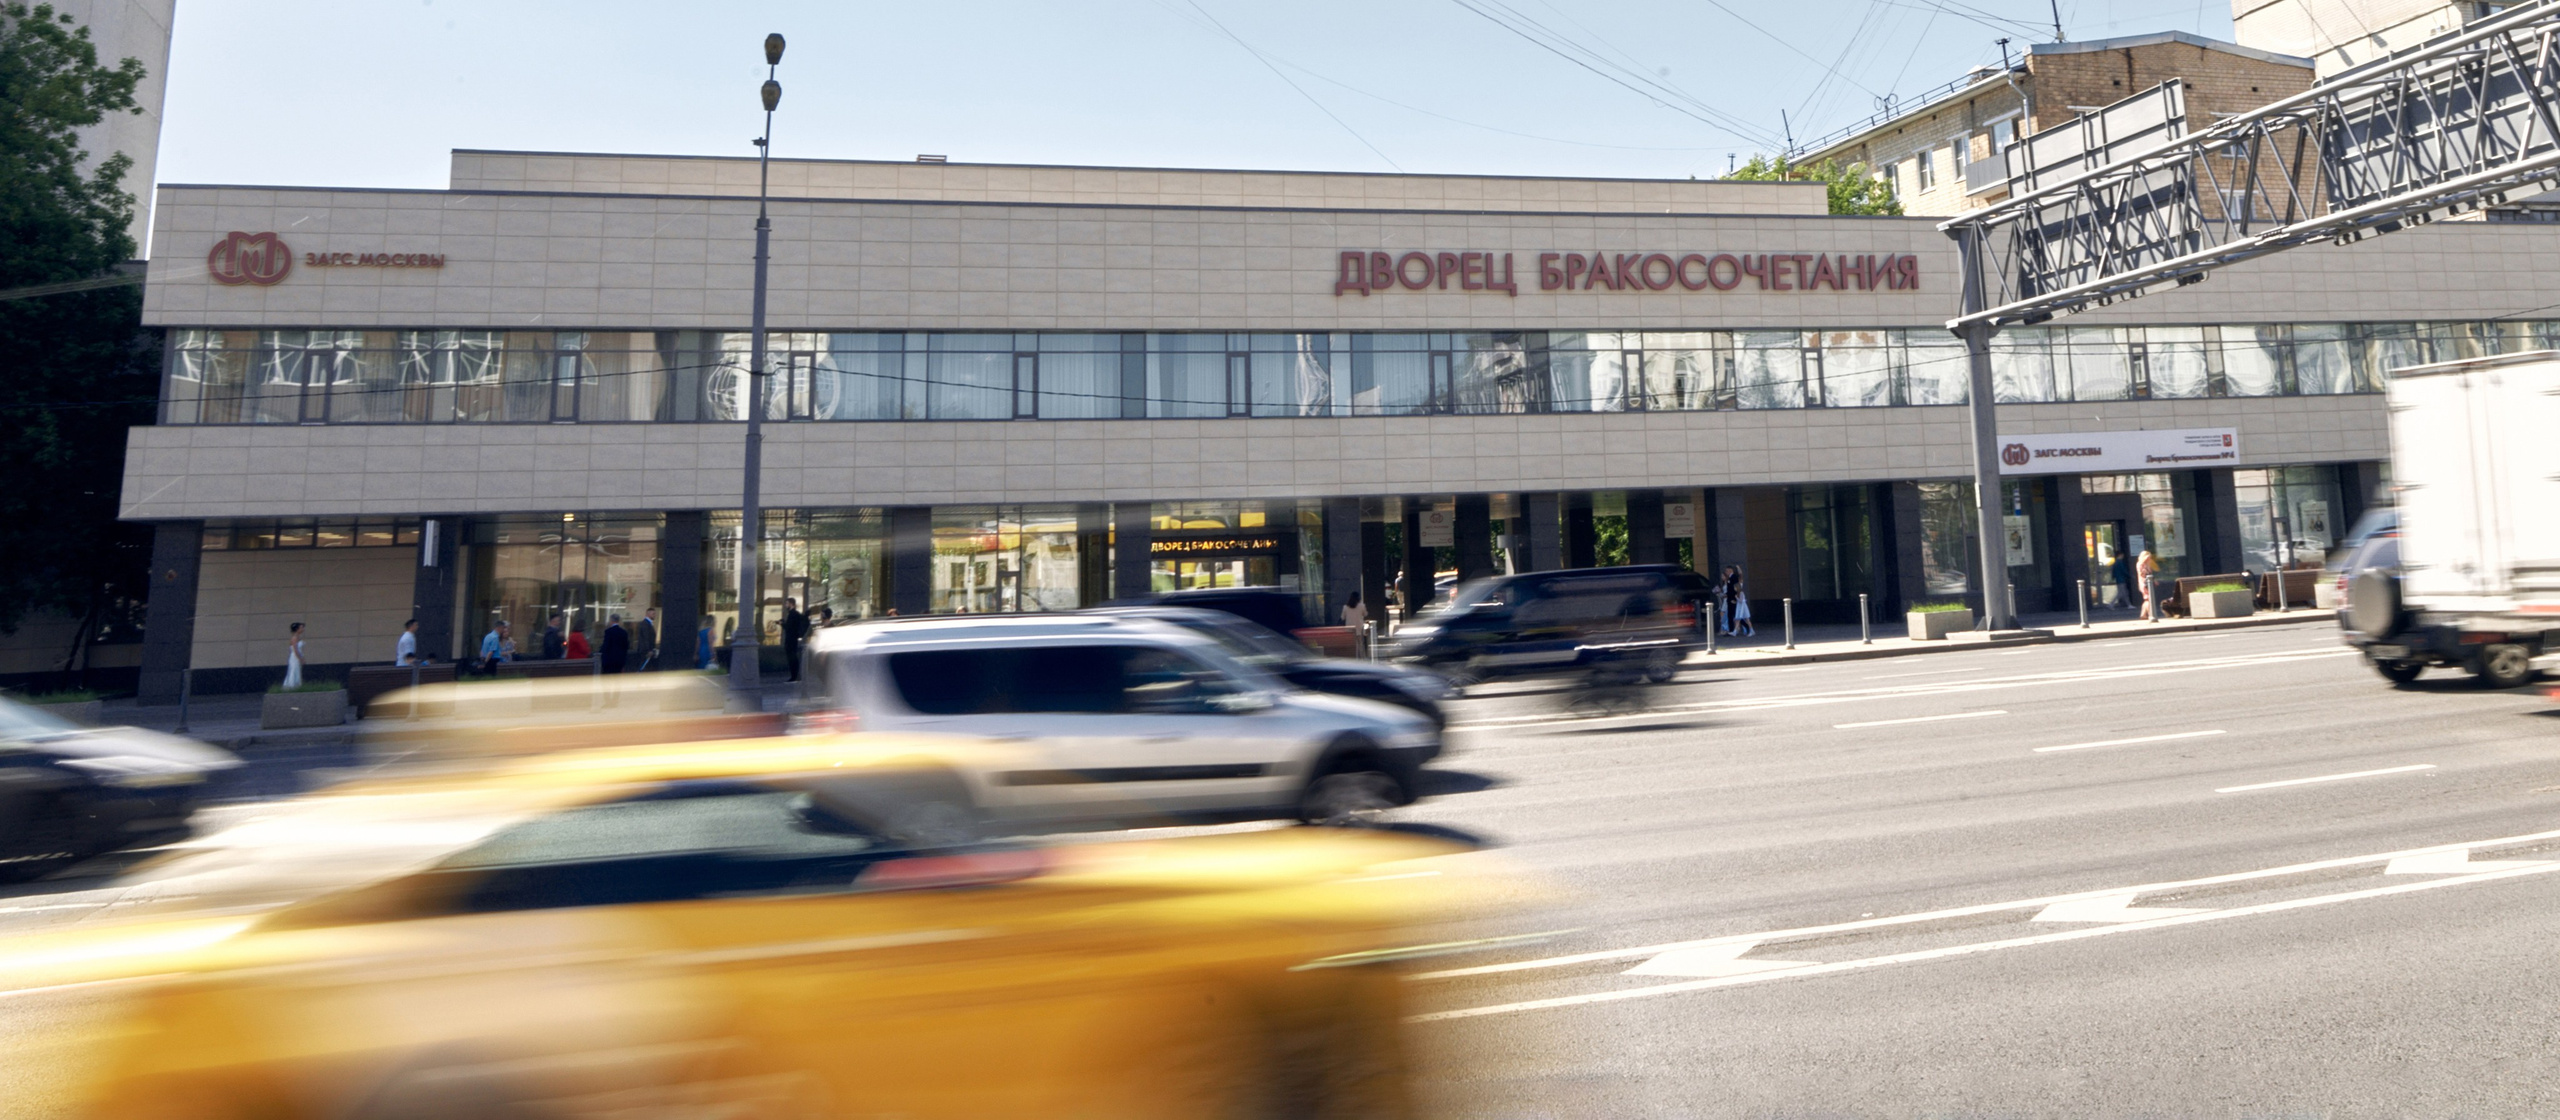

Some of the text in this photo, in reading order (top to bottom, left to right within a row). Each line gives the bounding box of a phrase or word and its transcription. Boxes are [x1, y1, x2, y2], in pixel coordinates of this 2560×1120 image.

[305, 252, 445, 267] ЗАГС МОСКВЫ
[1335, 251, 1920, 297] ДВОРЕЦ БРАКОСОЧЕТАНИЯ
[2034, 447, 2102, 458] ЗАГС МОСКВЫ
[1191, 539, 1278, 550] БРАКОСОЧЕАНИЯ
